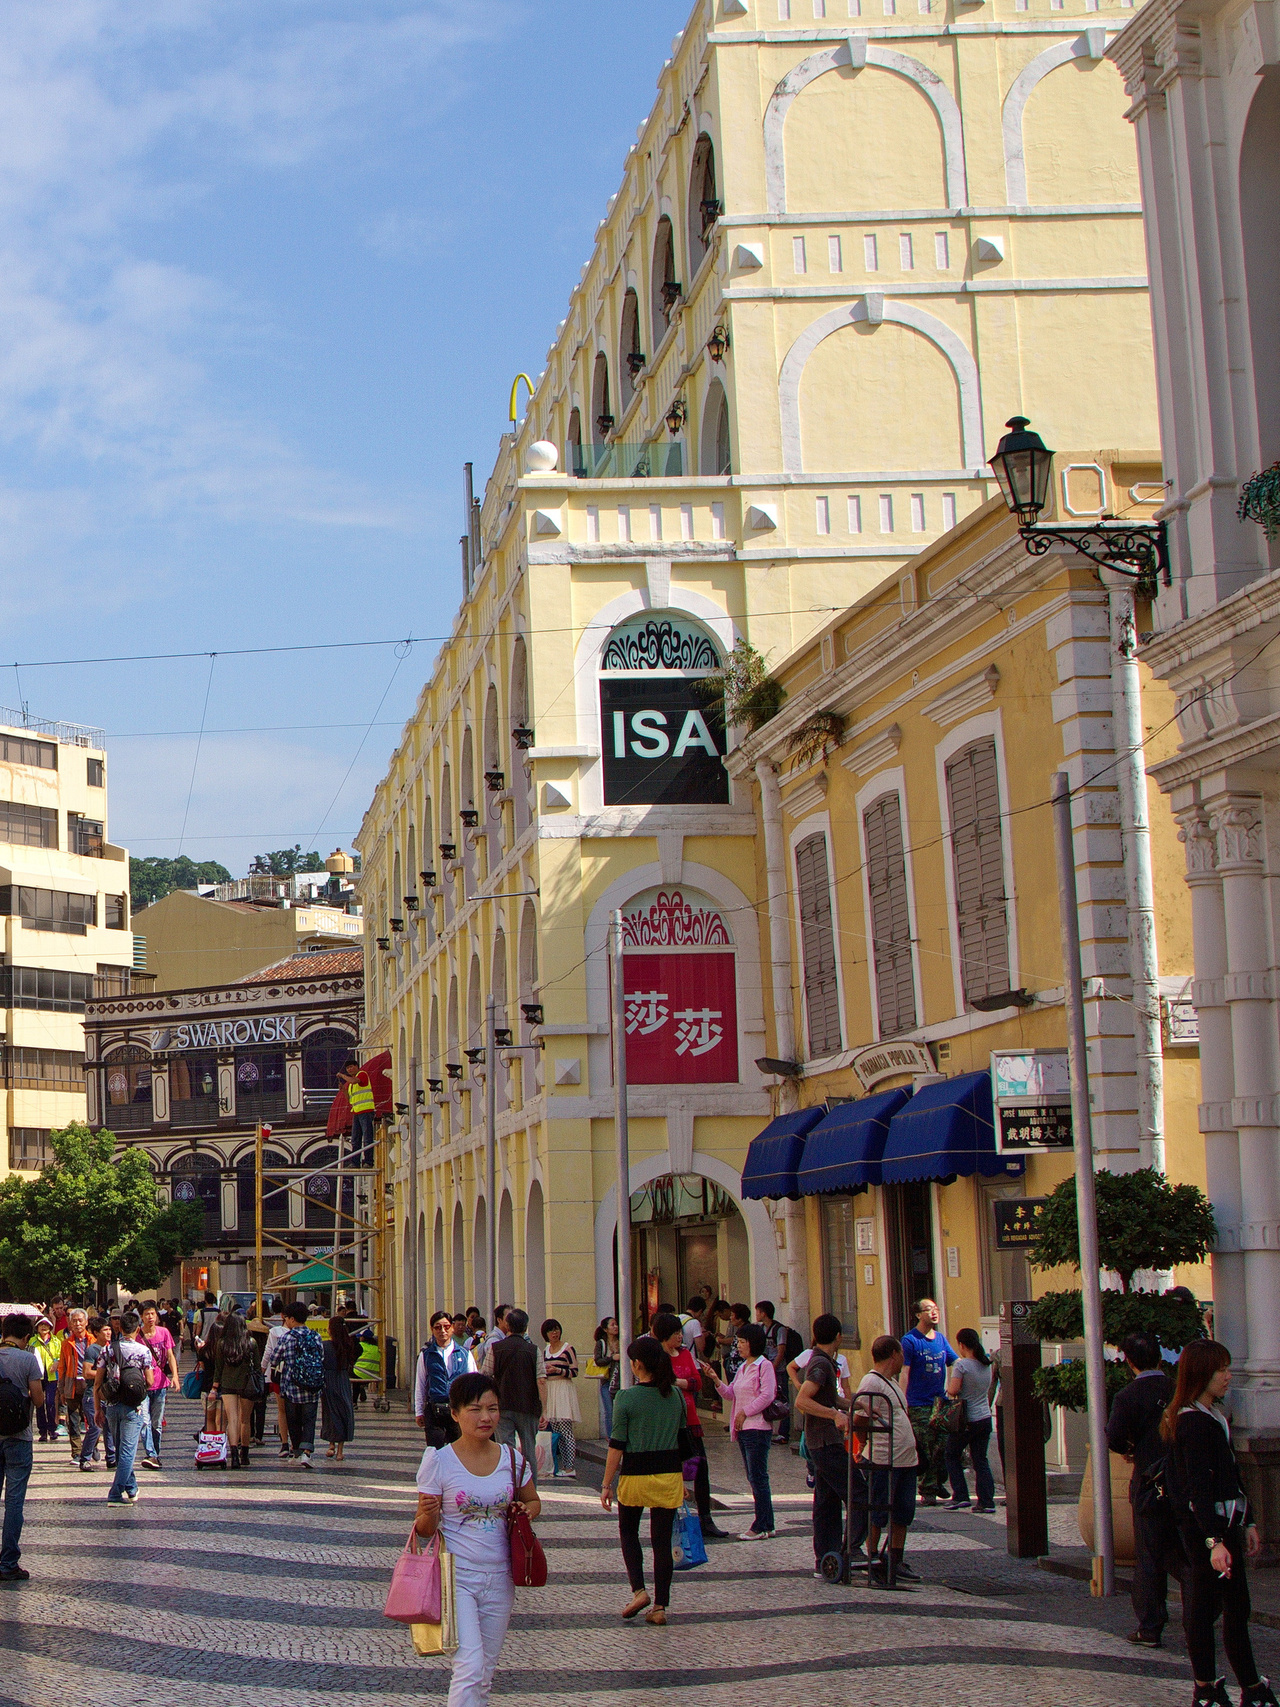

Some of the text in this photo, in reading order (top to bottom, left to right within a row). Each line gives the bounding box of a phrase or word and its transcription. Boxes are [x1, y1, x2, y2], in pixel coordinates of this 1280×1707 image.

[613, 708, 719, 759] ISA
[176, 1016, 297, 1049] SWAROVSKI
[623, 990, 723, 1057] 莎莎
[887, 1049, 918, 1067] POPULAR
[1002, 1109, 1016, 1118] JOSÉ
[1018, 1109, 1039, 1117] MANUEL
[1029, 1117, 1057, 1125] ADVOGADO
